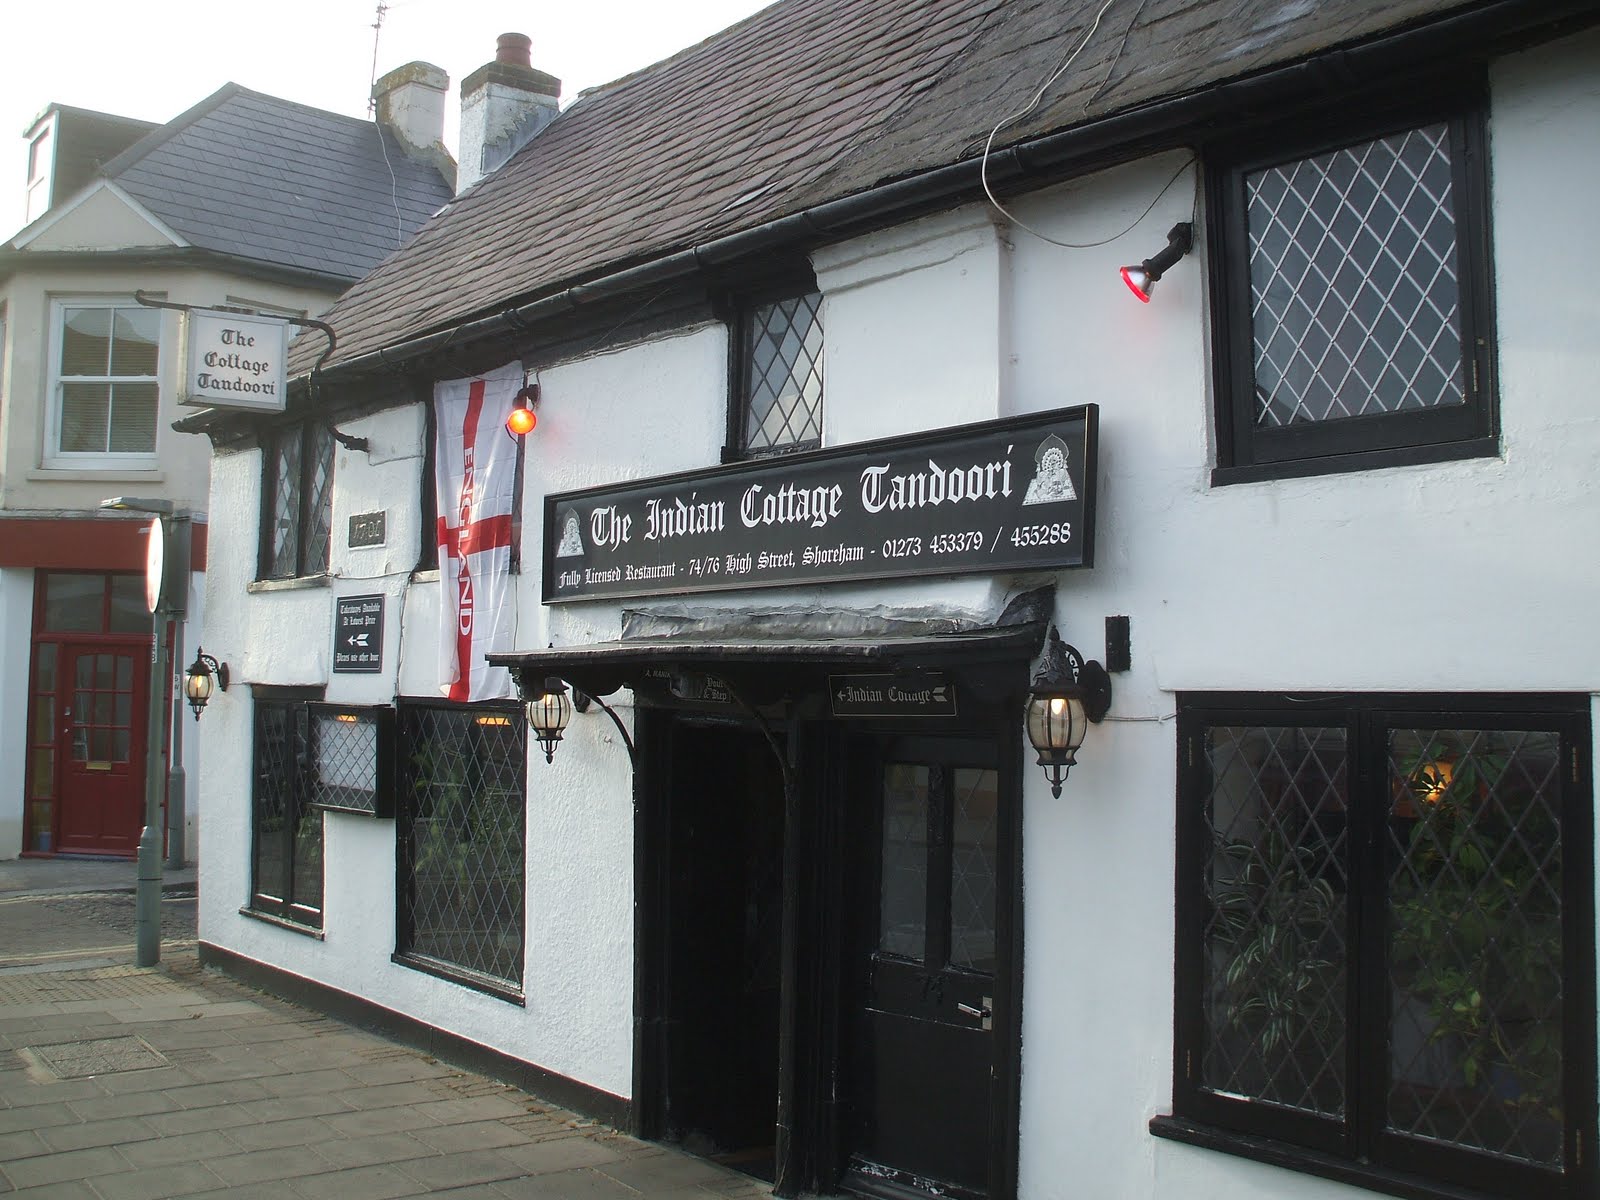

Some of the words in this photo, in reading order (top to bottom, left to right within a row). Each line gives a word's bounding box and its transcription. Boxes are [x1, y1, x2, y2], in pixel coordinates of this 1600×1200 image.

[221, 329, 255, 347] The
[204, 351, 269, 376] Cottage
[197, 373, 275, 395] Tandoori
[591, 504, 632, 551] The
[644, 492, 725, 541] Indian
[740, 482, 843, 528] Cottage
[860, 445, 1013, 514] Tandoori
[459, 448, 475, 636] ENGLAND
[558, 570, 581, 589] Fully
[585, 566, 621, 585] Licensed
[625, 561, 676, 581] Restaurant
[689, 556, 720, 578] 74/76
[725, 552, 751, 575] High
[757, 550, 796, 570] Street,
[801, 542, 864, 568] Shoreham
[882, 536, 922, 558] 01273
[929, 531, 983, 555] 453379
[1010, 522, 1071, 548] 455288
[846, 685, 883, 702] Indian
